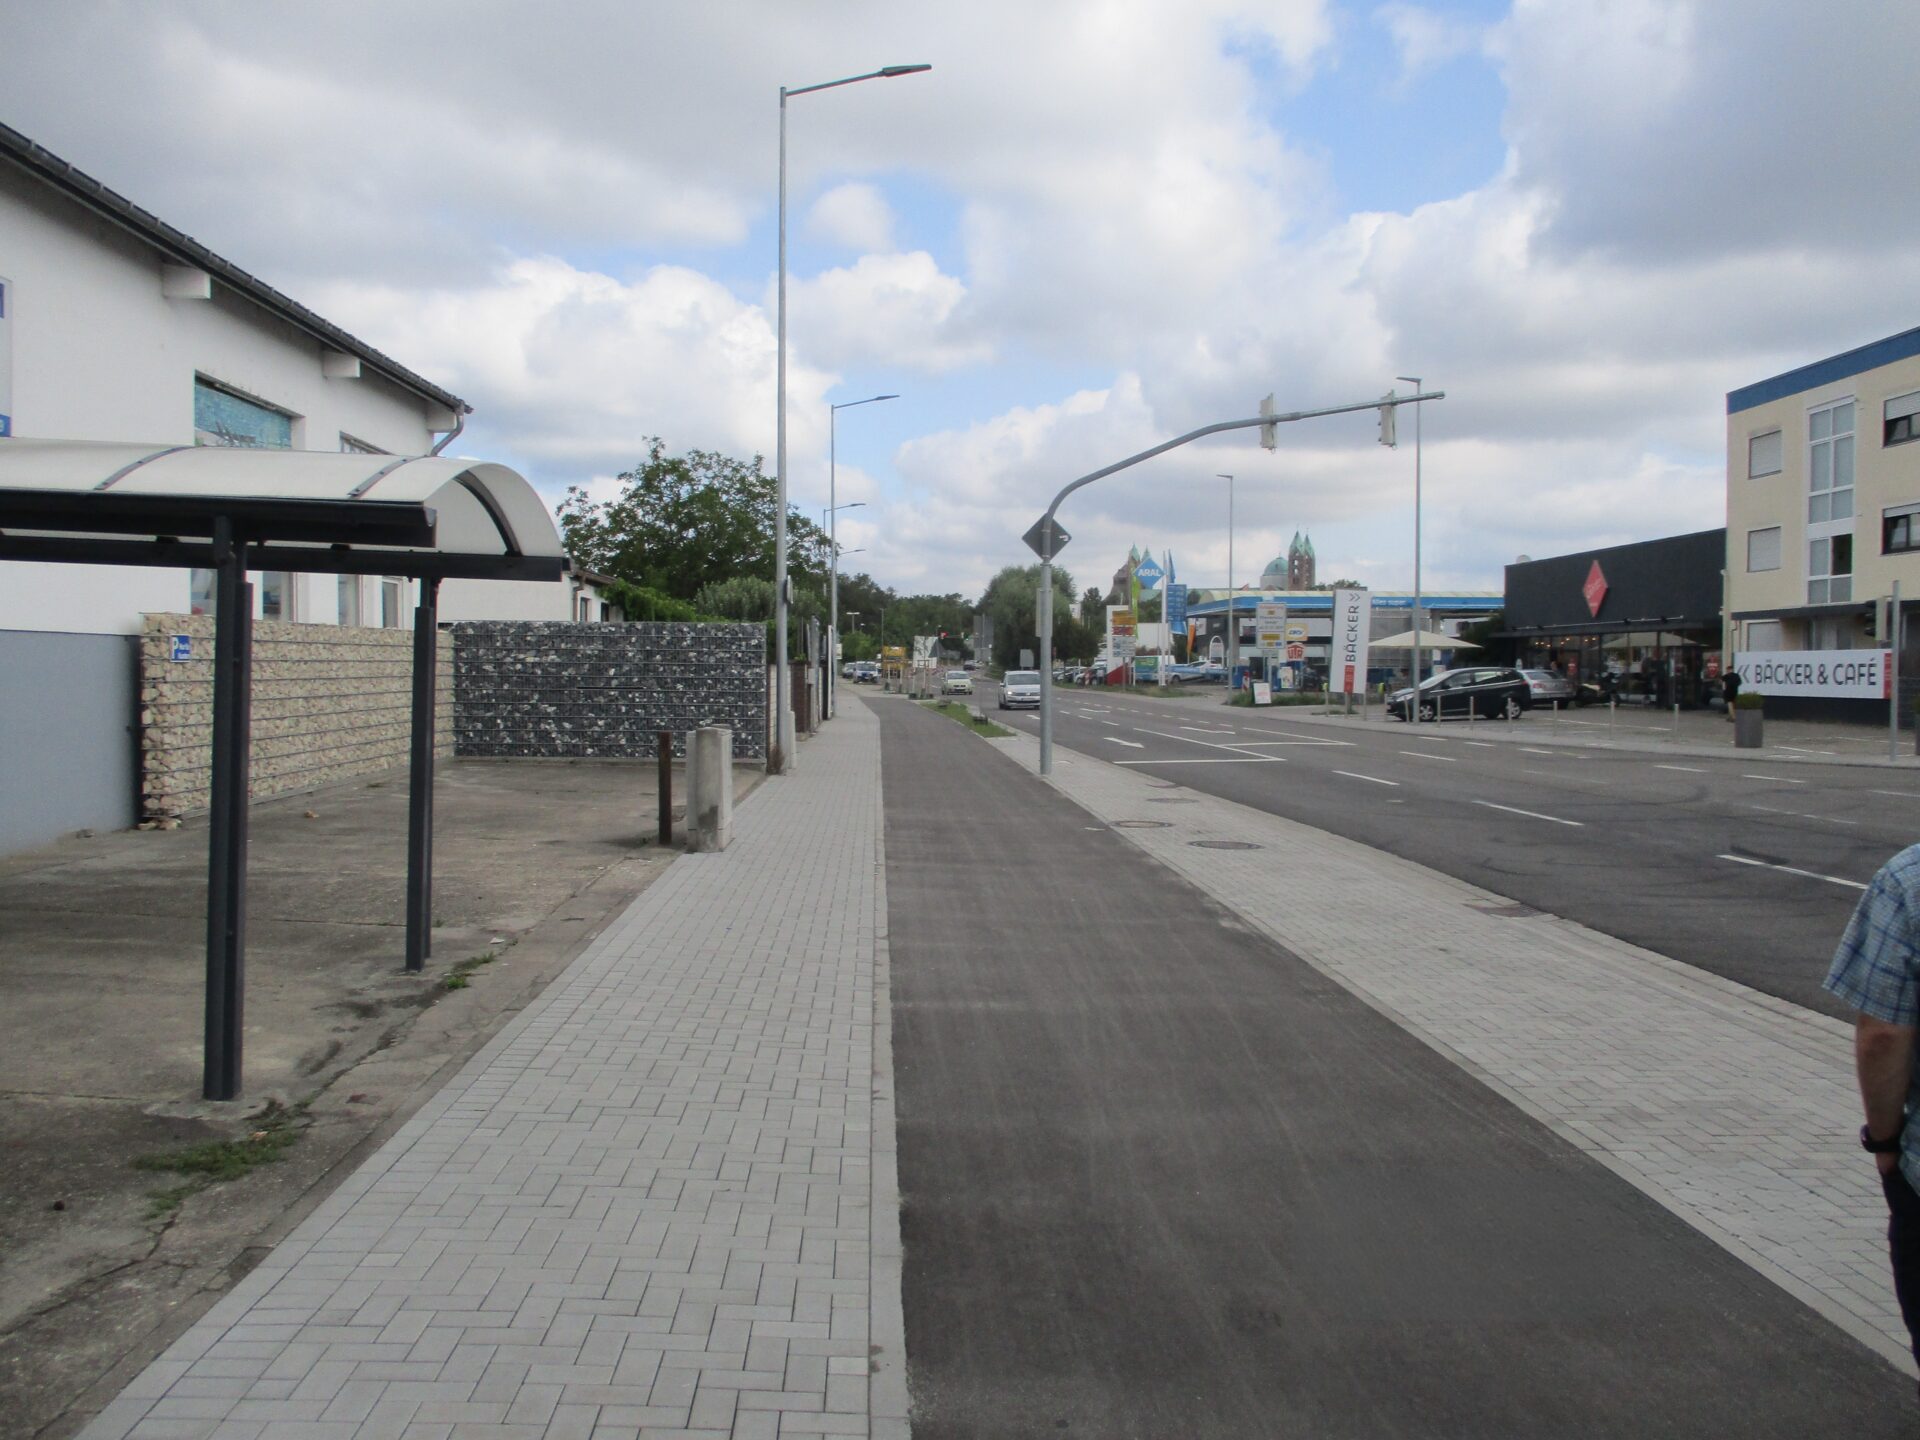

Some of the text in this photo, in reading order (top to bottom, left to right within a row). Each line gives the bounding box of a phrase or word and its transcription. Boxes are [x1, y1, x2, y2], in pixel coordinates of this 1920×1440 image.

[1137, 568, 1160, 577] ARAL
[1343, 605, 1360, 662] BÄCKER
[1754, 659, 1813, 685] BÄCKER
[1817, 663, 1829, 685] &
[1833, 657, 1877, 685] CAFÉ
